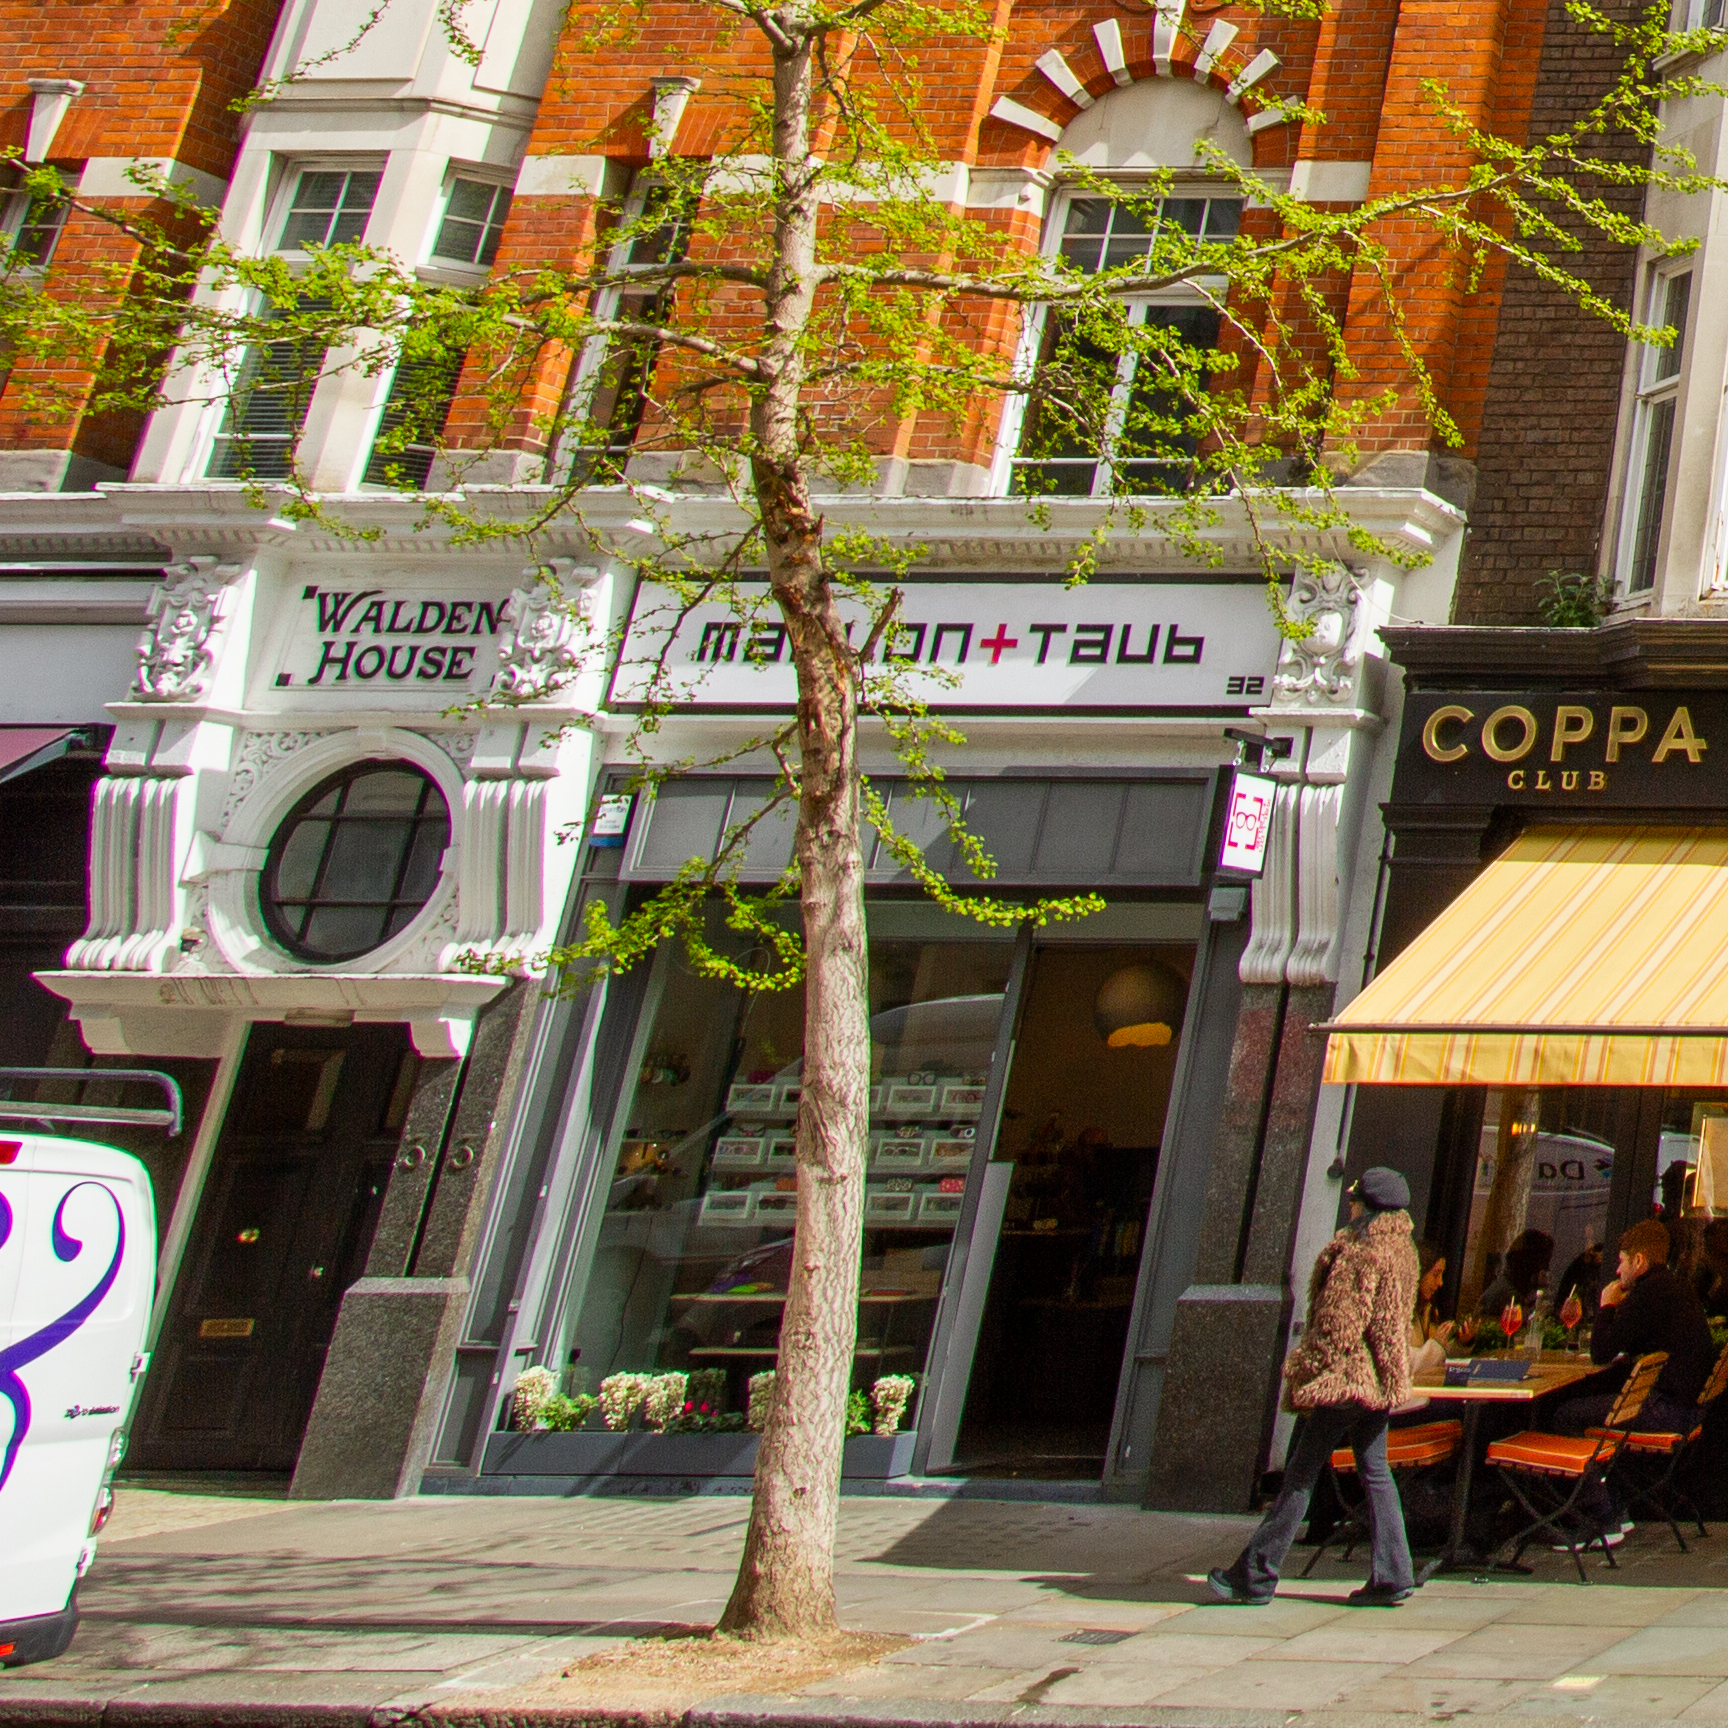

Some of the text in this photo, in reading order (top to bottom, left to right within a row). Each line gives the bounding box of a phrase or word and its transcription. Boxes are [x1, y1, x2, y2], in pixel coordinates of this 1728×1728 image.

[316, 590, 510, 634] WALDEN
[307, 641, 477, 684] HOUSE
[1226, 676, 1264, 695] 32
[1422, 705, 1707, 763] COPPA
[1507, 770, 1606, 790] CLUB
